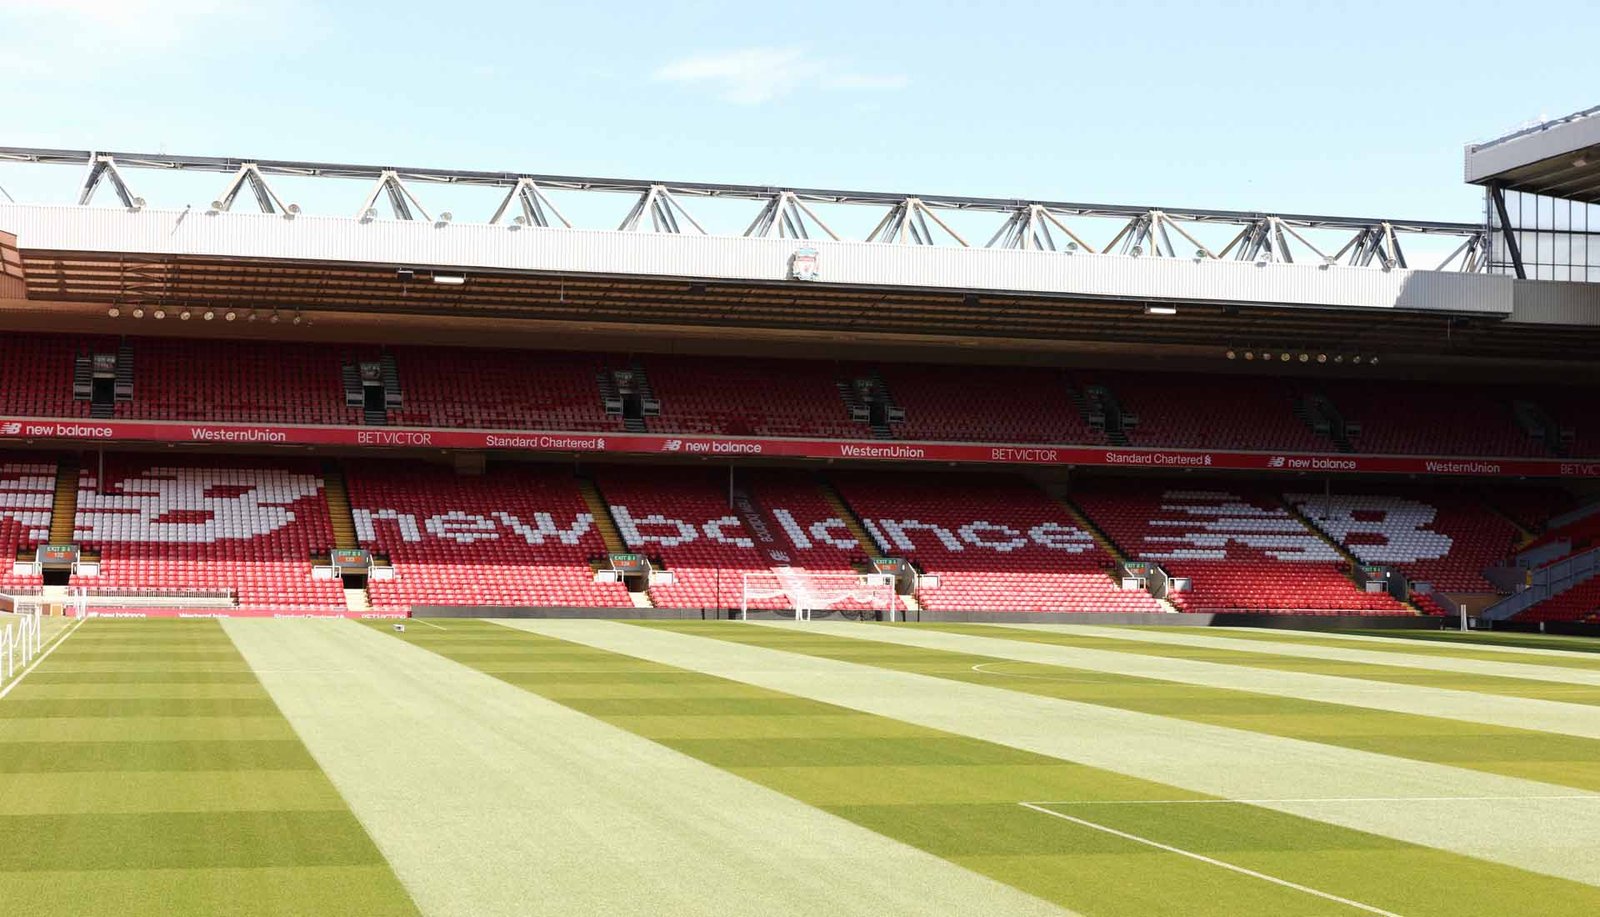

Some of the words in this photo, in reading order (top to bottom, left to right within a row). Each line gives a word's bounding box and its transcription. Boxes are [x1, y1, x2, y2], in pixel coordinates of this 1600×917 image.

[26, 425, 55, 436] new
[56, 423, 113, 438] balance
[191, 428, 286, 443] WesternUnion
[357, 431, 432, 445] BETVICTOR
[486, 435, 537, 447] Standard
[539, 436, 595, 449] Chartered
[685, 442, 710, 452] new
[712, 440, 762, 454] balance
[840, 444, 925, 459] WesternUnion
[991, 448, 1058, 462] BETVICTOR
[1105, 452, 1152, 465] Standard
[1153, 453, 1203, 466] Chartered
[1288, 458, 1311, 469] new
[1312, 456, 1357, 470] balance
[1425, 460, 1501, 474] WesternUnion
[352, 508, 594, 546] new
